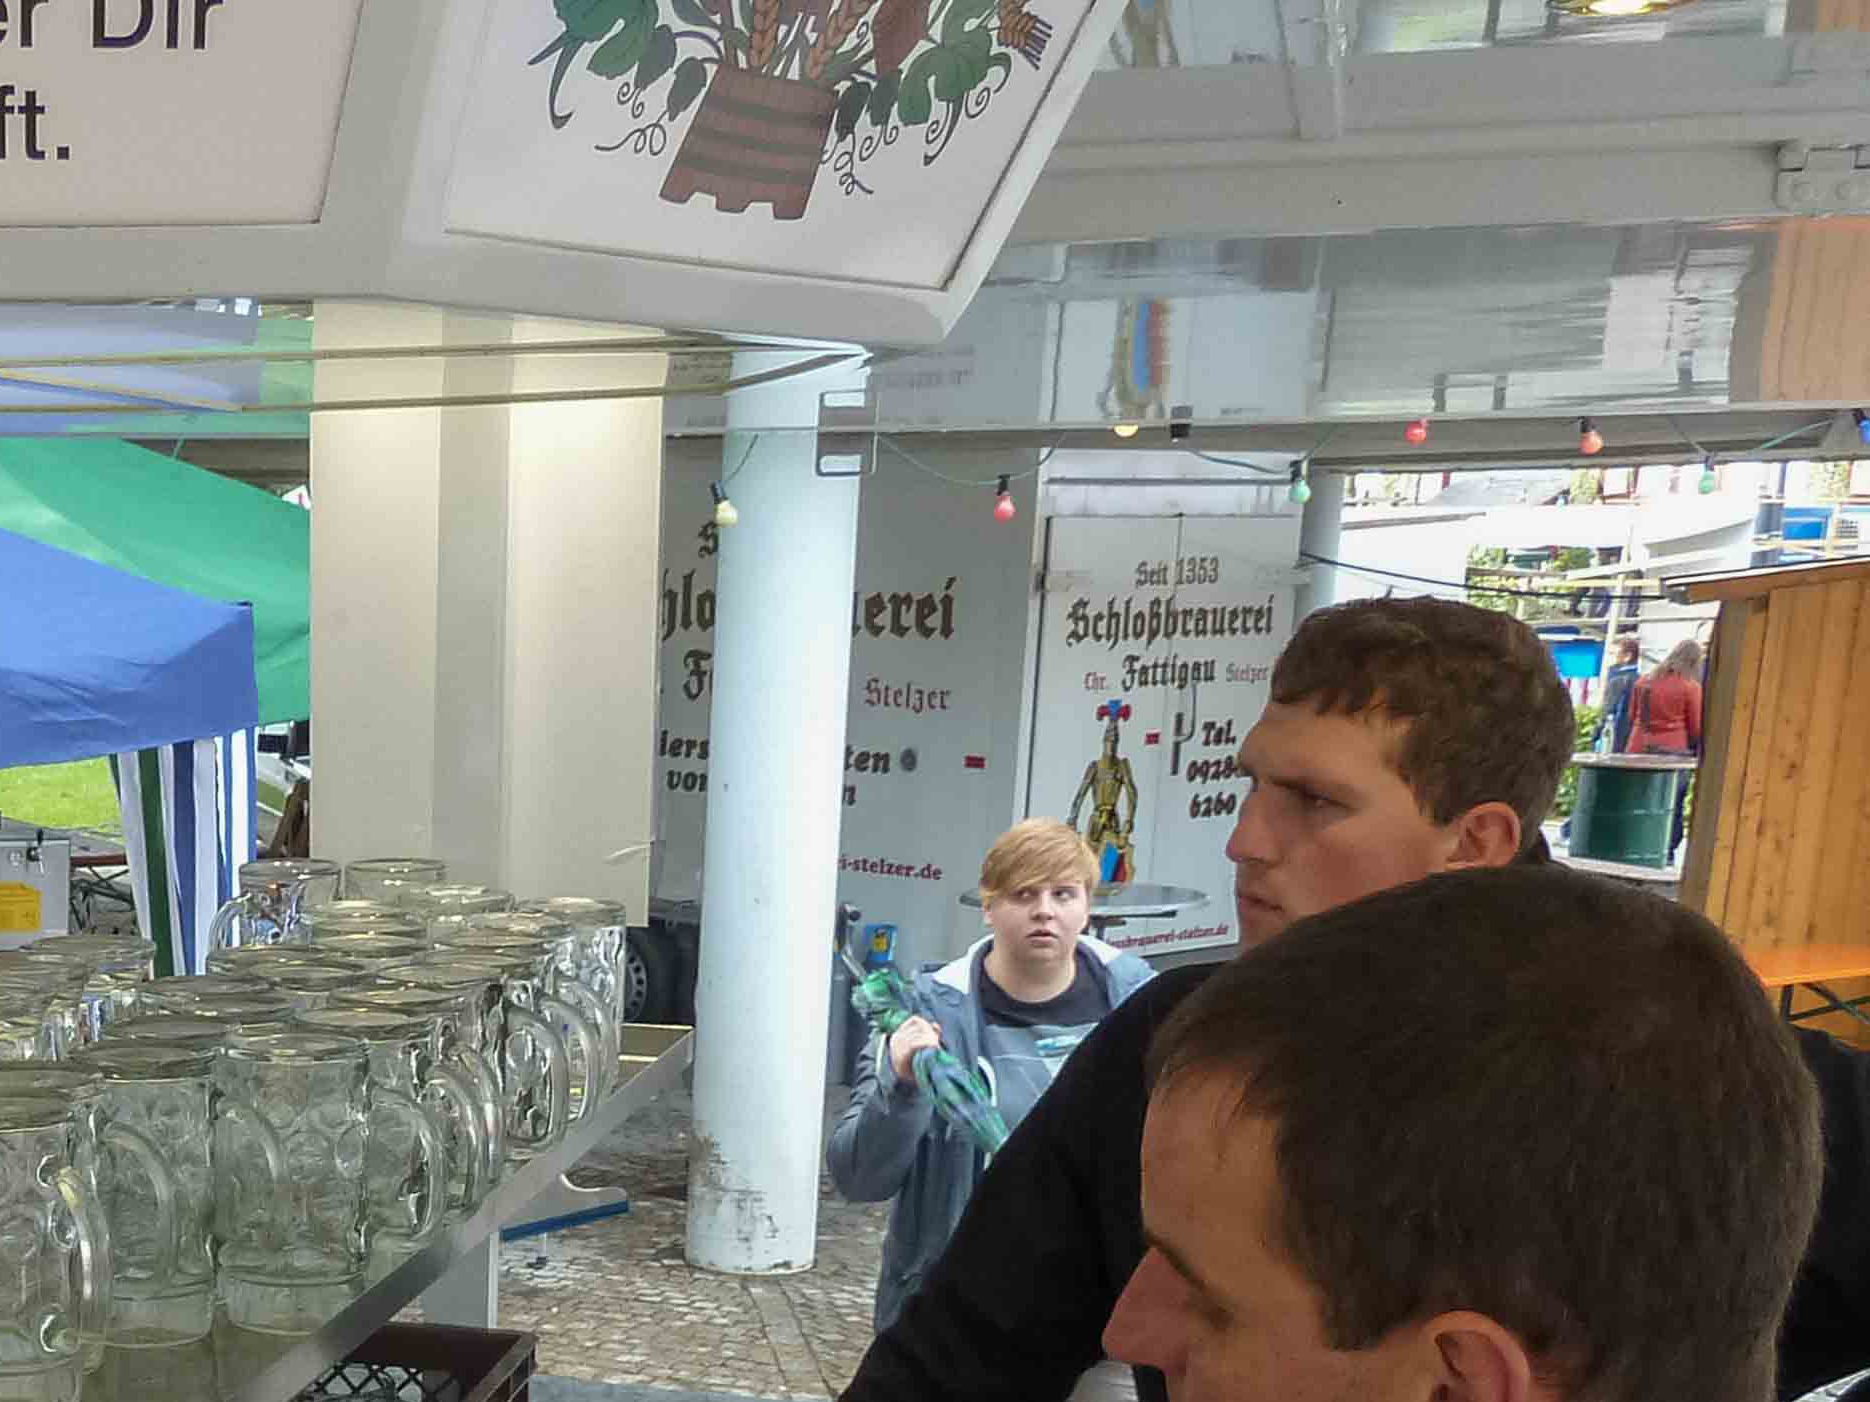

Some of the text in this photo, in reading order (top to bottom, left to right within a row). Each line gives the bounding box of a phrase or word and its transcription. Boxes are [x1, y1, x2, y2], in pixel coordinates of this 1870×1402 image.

[92, 0, 224, 50] Dir
[1135, 556, 1219, 589] Seit 1353
[1066, 594, 1274, 650] Schloßbrauerei
[1122, 653, 1216, 692] Fattigau
[864, 677, 952, 714] Stelzer
[1202, 719, 1236, 747] Tel.
[1186, 755, 1236, 784] 0928
[1189, 791, 1237, 819] 6260
[839, 854, 944, 881] i-stelzer.de
